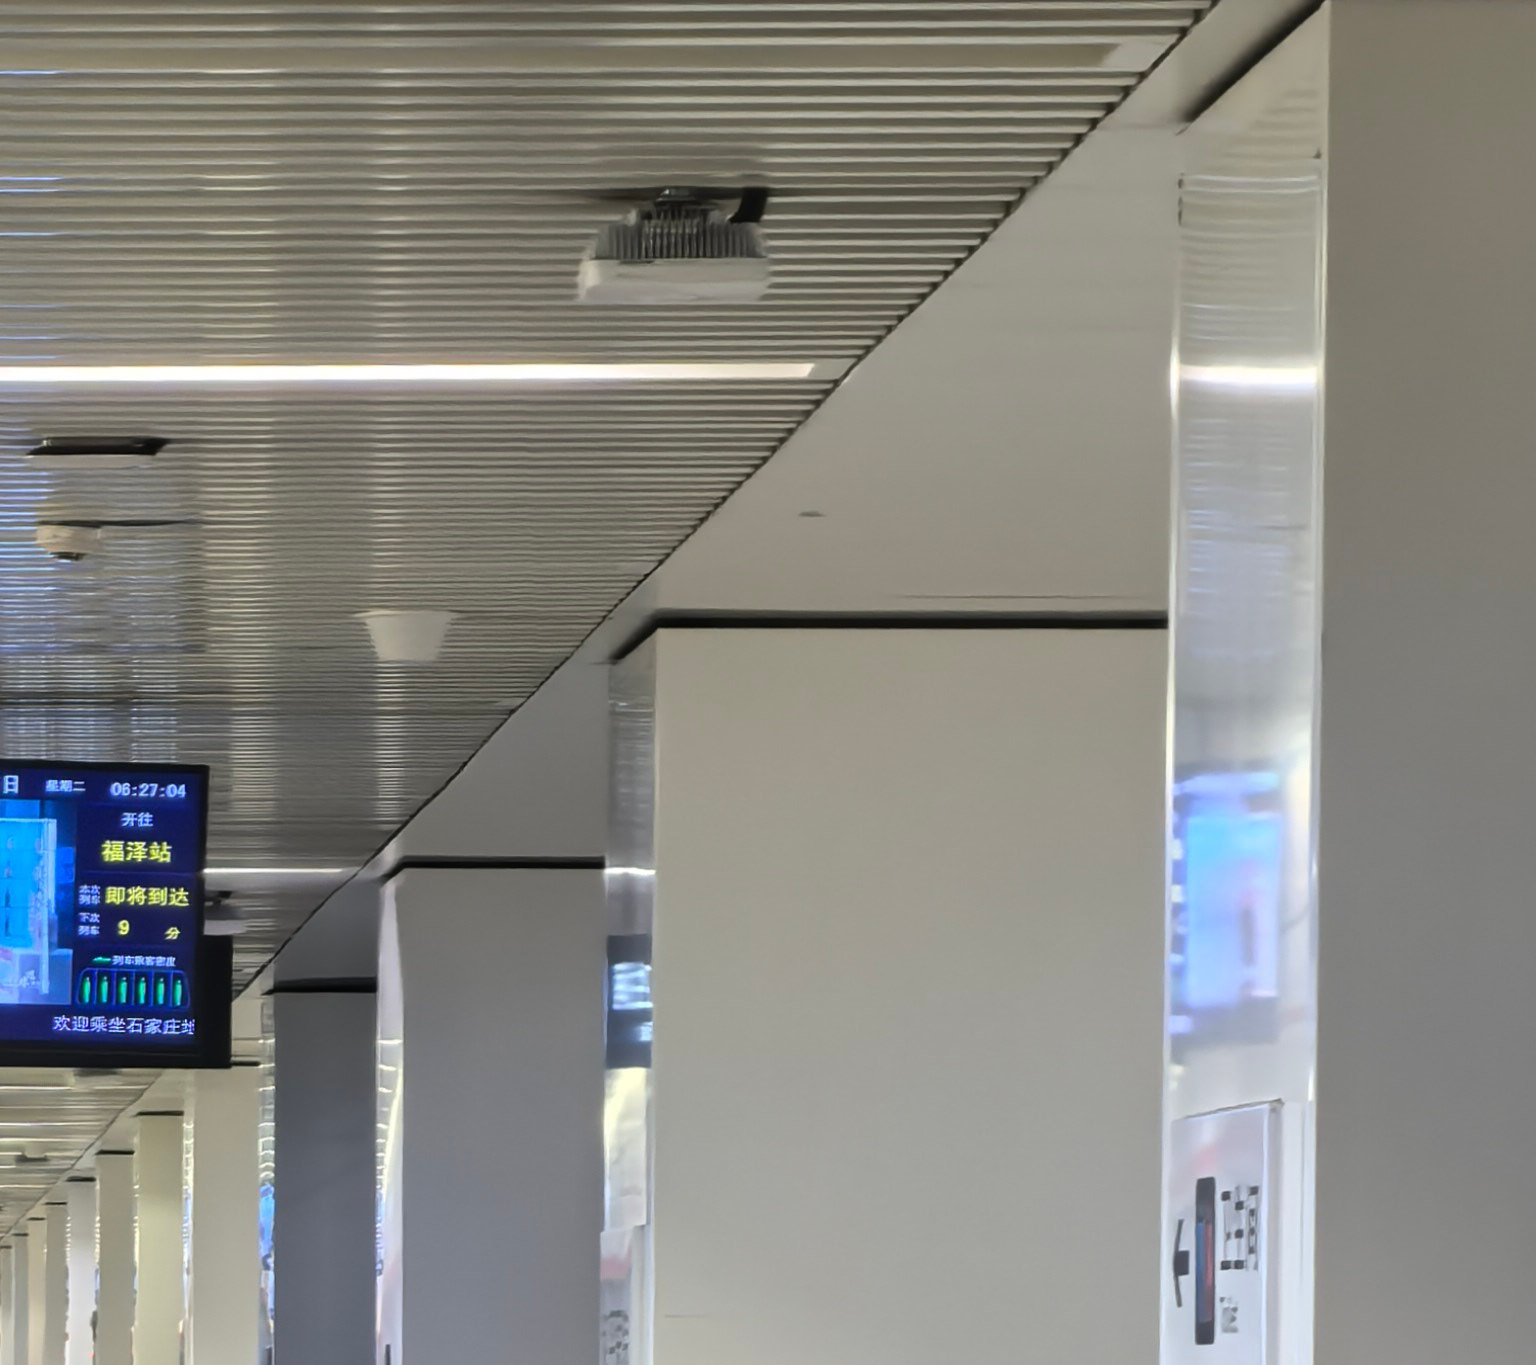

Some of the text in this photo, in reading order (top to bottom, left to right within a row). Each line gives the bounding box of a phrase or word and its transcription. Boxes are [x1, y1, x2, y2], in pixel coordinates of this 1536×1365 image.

[44, 779, 86, 793] 星期二
[109, 781, 187, 799] 06:27:04
[121, 812, 154, 827] 开往
[100, 839, 173, 863] 福泽站
[104, 885, 190, 907] 即将到达
[116, 919, 130, 936] 9
[164, 926, 182, 940] 分
